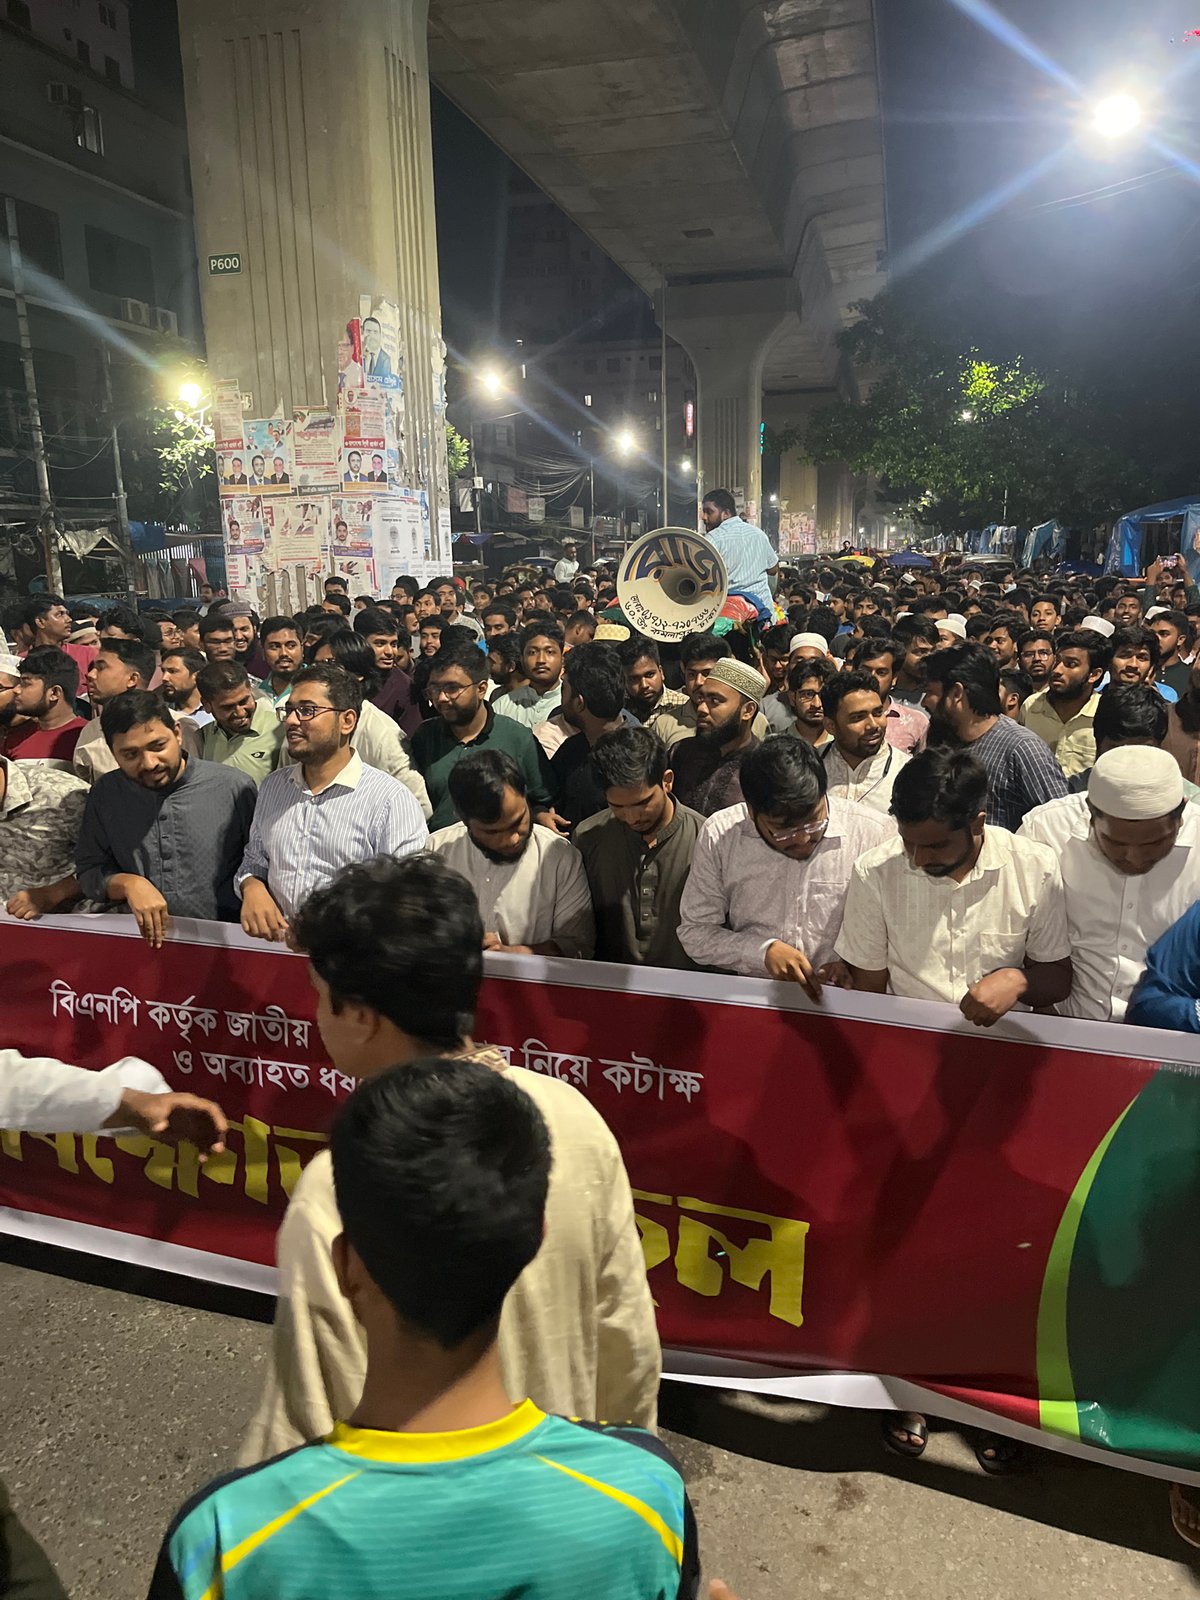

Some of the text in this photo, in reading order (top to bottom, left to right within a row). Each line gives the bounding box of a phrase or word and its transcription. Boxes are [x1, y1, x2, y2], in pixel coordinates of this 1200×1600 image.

[210, 257, 239, 271] P600
[49, 979, 141, 1027] বিএনপি
[145, 995, 218, 1043] কর্তৃক
[224, 1005, 312, 1049] জাতীয়
[598, 1052, 704, 1103] কটাক্ষ
[173, 1050, 193, 1074] ও
[199, 1051, 311, 1091] অব্যাহত
